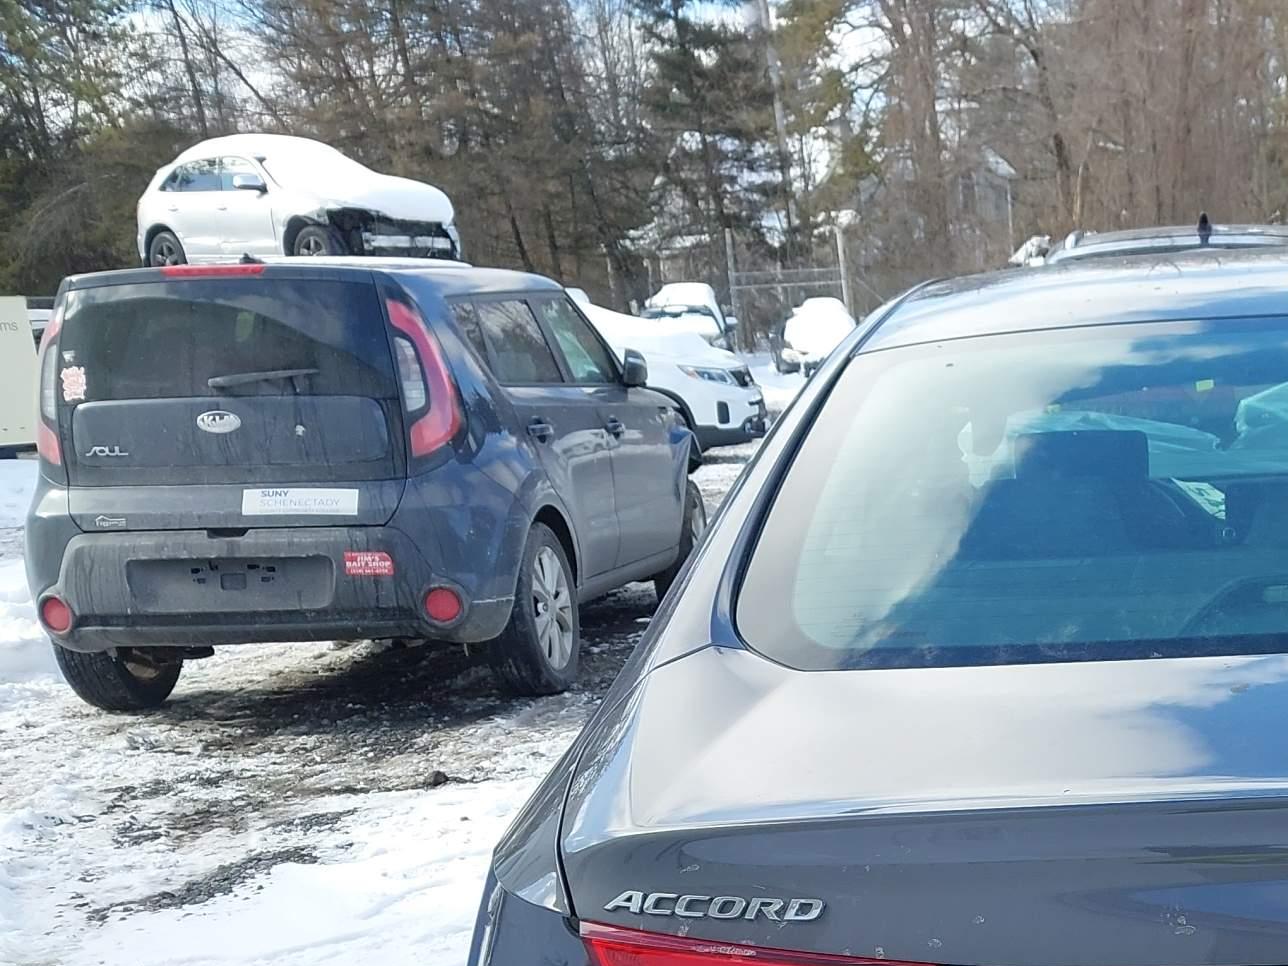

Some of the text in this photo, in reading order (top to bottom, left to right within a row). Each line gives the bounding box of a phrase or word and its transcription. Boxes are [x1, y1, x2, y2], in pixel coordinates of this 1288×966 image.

[85, 445, 129, 457] SOUL
[260, 489, 289, 498] SUNY
[259, 498, 341, 508] SCHENECTADY
[345, 560, 392, 568] BAIT SHOP
[603, 889, 826, 922] ACCORD
